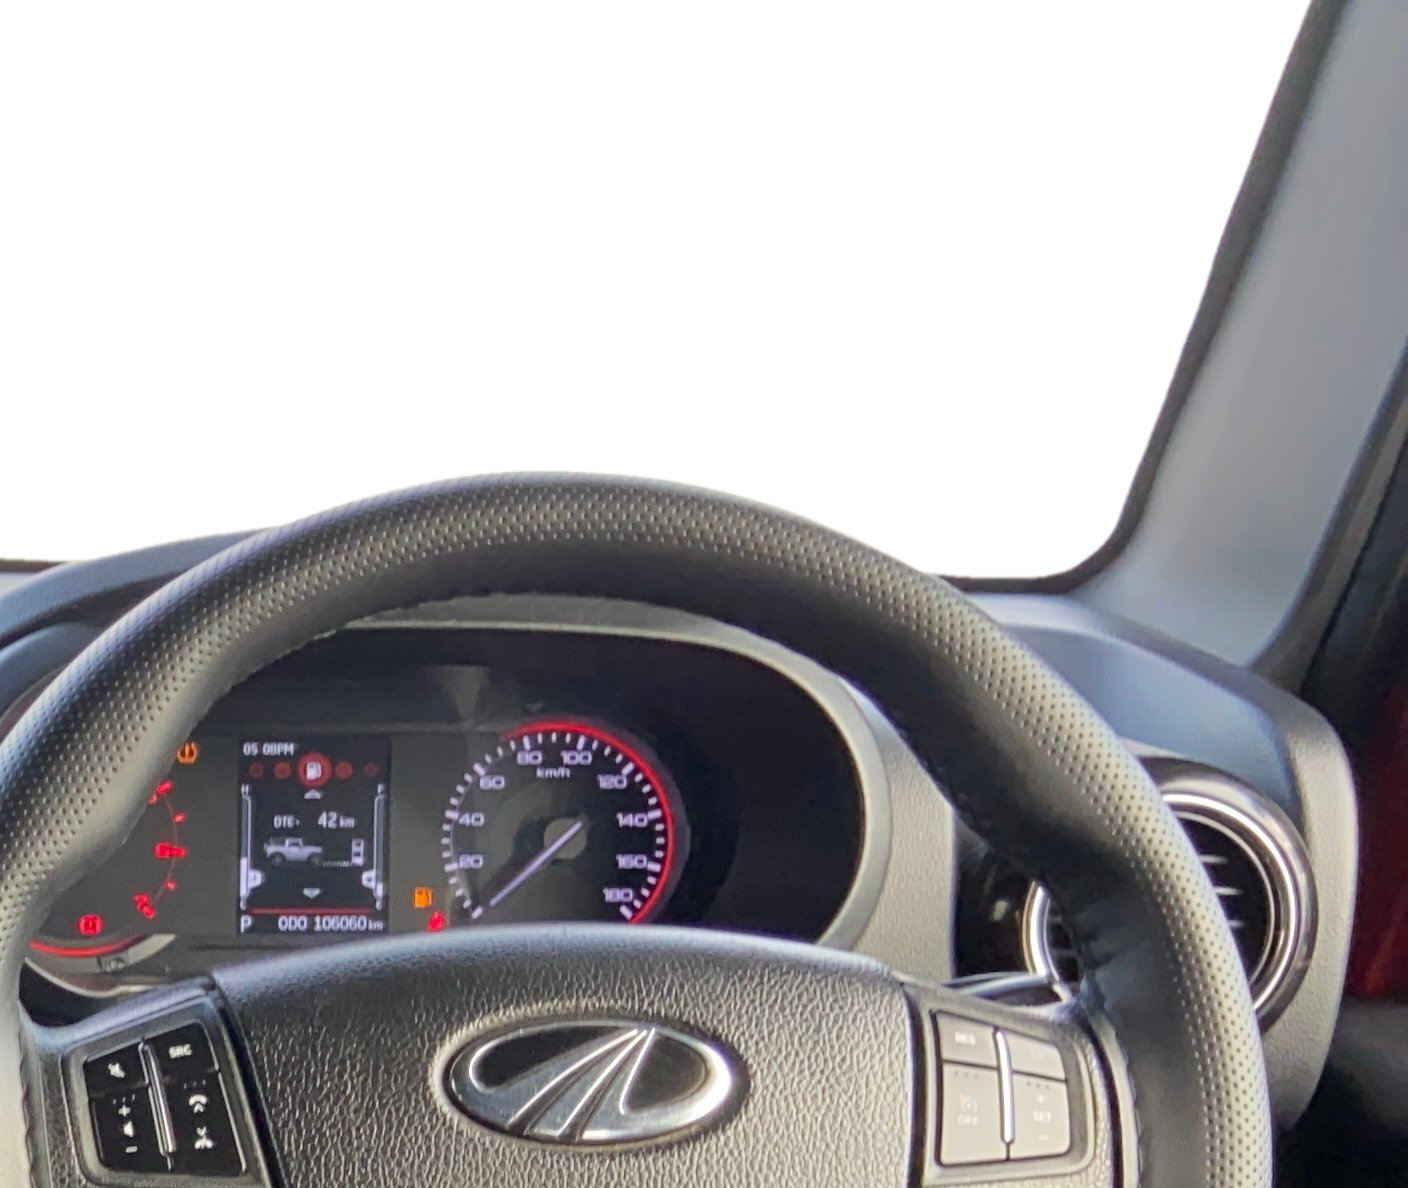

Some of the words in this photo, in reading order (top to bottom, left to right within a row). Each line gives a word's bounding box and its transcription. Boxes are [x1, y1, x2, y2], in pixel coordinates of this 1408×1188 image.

[560, 750, 592, 765] 100
[536, 767, 570, 778] km/h
[318, 811, 337, 829] 42
[339, 816, 355, 829] km
[458, 813, 484, 827] 40
[616, 813, 648, 828] 140
[240, 916, 252, 933] P
[278, 915, 307, 931] ODO
[368, 918, 383, 931] km
